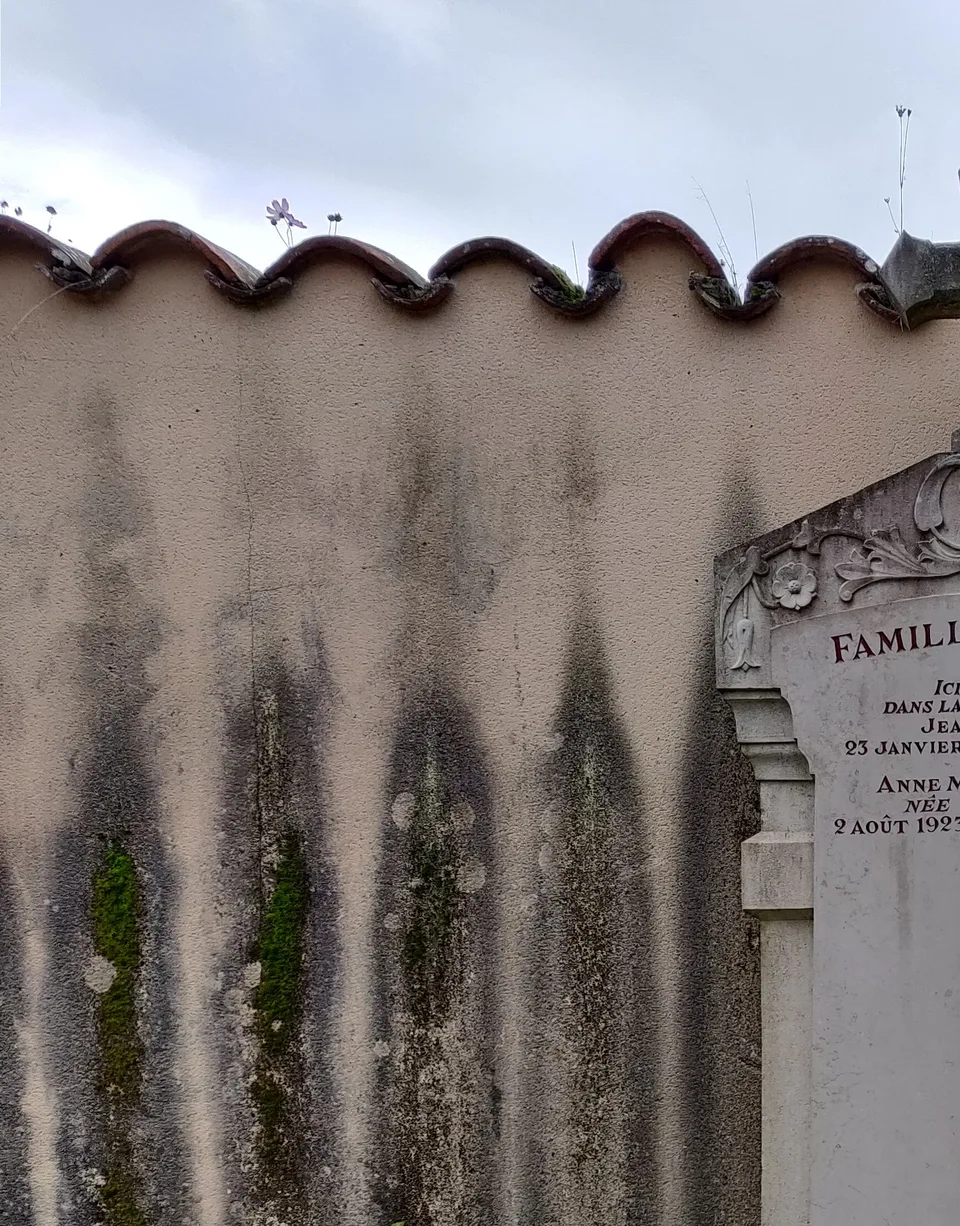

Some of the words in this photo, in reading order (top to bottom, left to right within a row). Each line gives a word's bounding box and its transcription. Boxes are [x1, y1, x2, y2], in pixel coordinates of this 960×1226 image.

[883, 700, 933, 714] DANS
[845, 740, 868, 756] 23
[876, 775, 941, 793] ANNE
[903, 794, 950, 813] NÉE
[834, 818, 846, 835] 2
[850, 814, 908, 835] AOÛT
